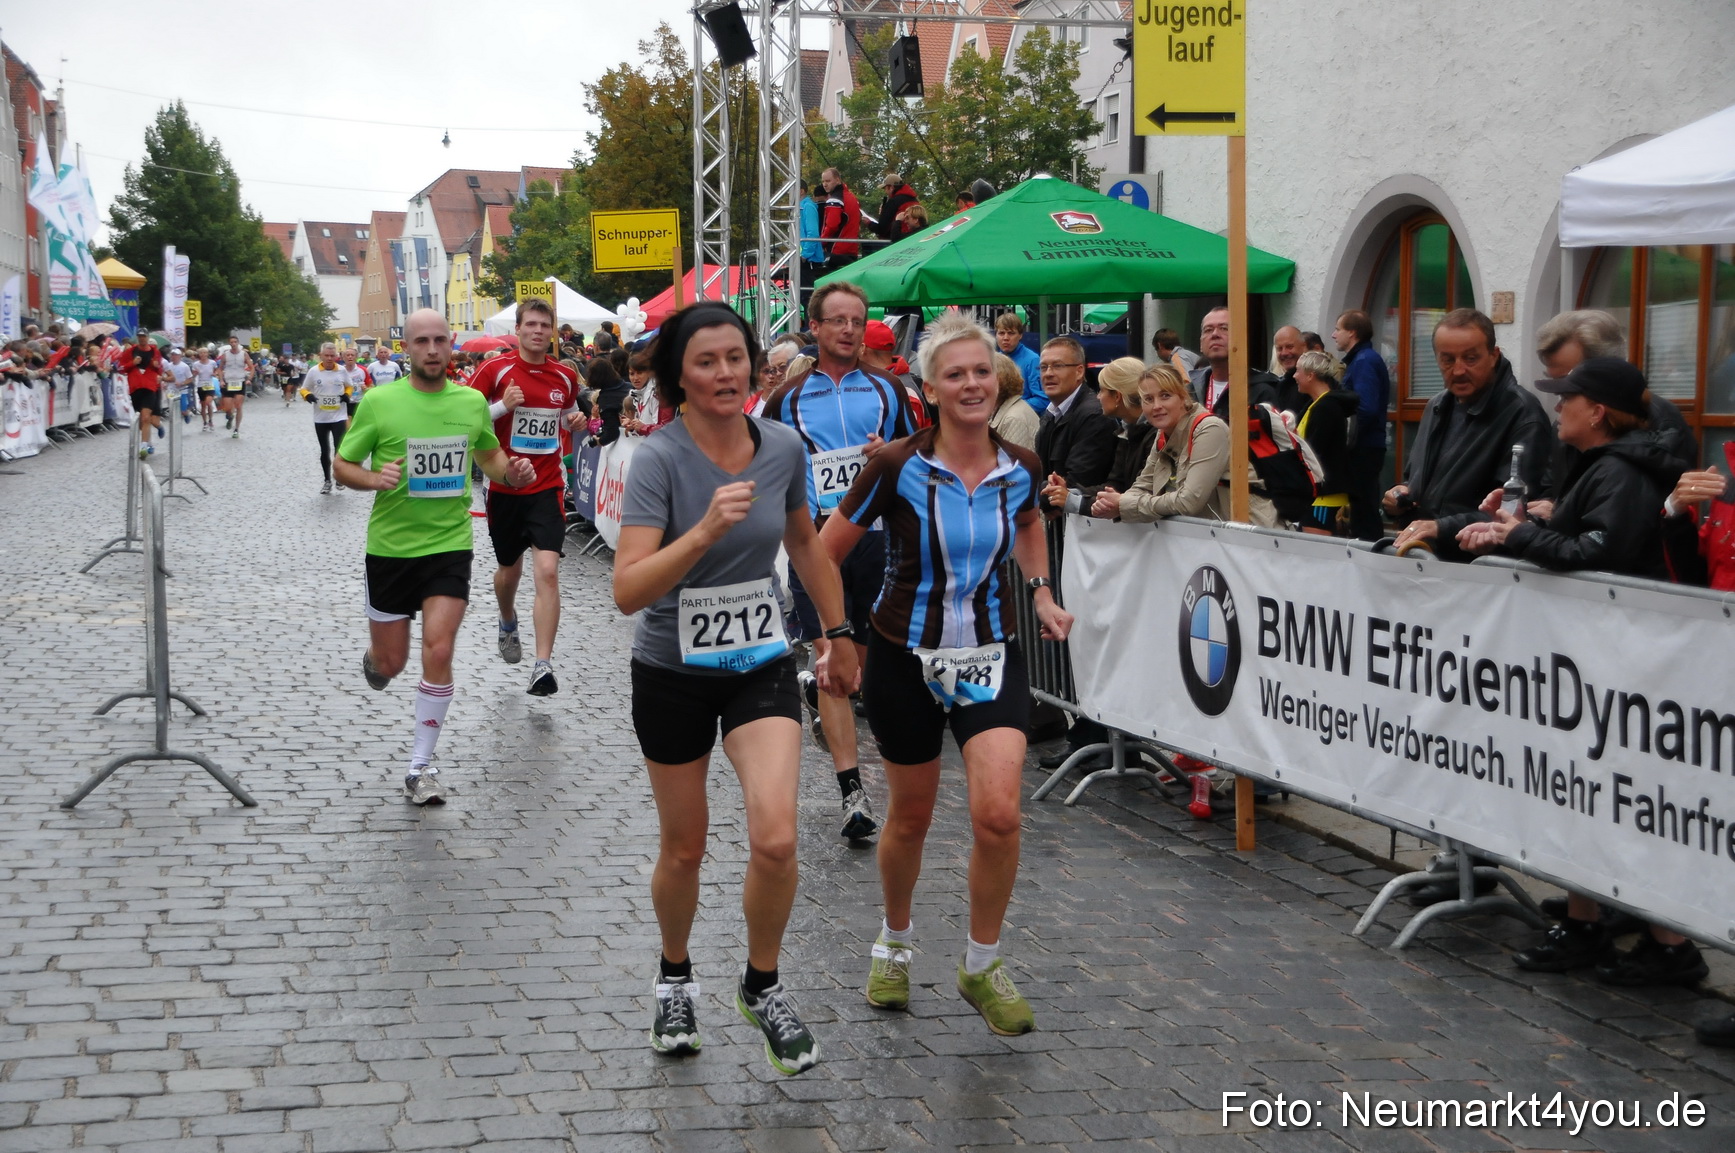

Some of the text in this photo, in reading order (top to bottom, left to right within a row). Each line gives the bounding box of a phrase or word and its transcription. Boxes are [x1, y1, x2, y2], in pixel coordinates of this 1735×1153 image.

[1138, 0, 1242, 33] Jugend-
[1168, 34, 1215, 62] lauf
[598, 229, 673, 241] Schnupper-
[624, 244, 648, 255] lauf
[1037, 238, 1148, 249] Neumarkter
[1022, 247, 1177, 261] Lammsbräu
[520, 284, 552, 295] Block
[188, 308, 197, 320] B
[322, 397, 337, 405] 526
[517, 418, 556, 437] 2648
[431, 442, 460, 450] Neumarkt
[525, 440, 547, 449] Jürgen
[414, 450, 465, 475] 3047
[813, 452, 867, 467] PARTL Neumark
[820, 462, 868, 491] 242
[425, 479, 458, 489] Norbert
[681, 590, 764, 608] PARTL Neumarkt
[690, 603, 774, 648] 2212
[1257, 595, 1354, 677] BMW
[718, 654, 756, 669] Heike
[950, 654, 991, 666] Neumarkt
[1259, 676, 1358, 745] Weniger
[1362, 703, 1513, 789] Verbrauch.
[1523, 745, 1602, 817] Mehr
